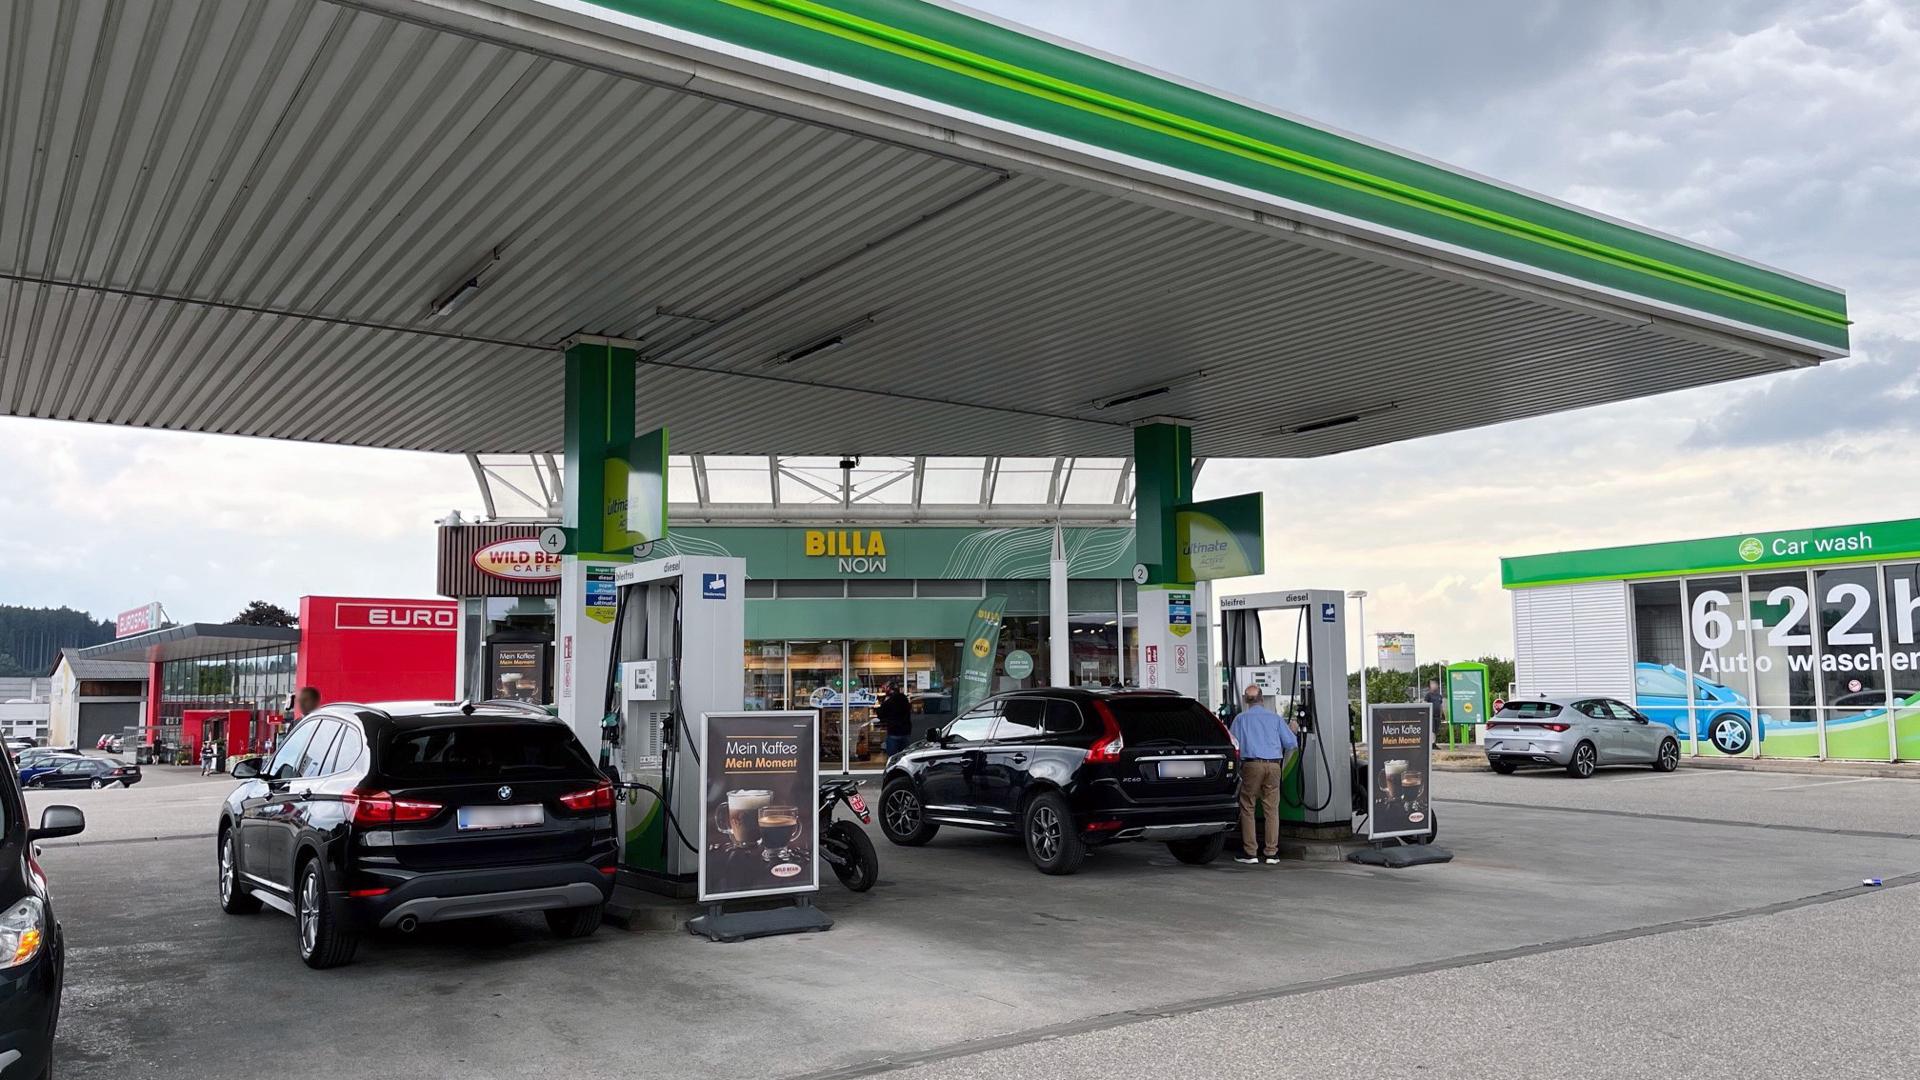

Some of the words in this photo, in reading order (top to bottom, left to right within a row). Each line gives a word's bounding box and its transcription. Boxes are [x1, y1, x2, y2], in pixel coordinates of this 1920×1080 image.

[547, 533, 557, 547] 4
[805, 531, 886, 556] BILLA
[1772, 538, 1809, 556] Car
[1814, 531, 1872, 551] wash
[489, 551, 530, 564] WILD
[513, 564, 552, 572] CAFE
[664, 561, 681, 573] diesel
[838, 557, 887, 573] NOW
[1137, 569, 1144, 579] 2
[1220, 598, 1246, 607] bleifrei
[1286, 593, 1309, 602] diesel
[368, 609, 453, 626] EURO
[975, 644, 988, 653] NEU
[1699, 650, 1773, 673] Auto
[1382, 725, 1400, 735] Mein
[1401, 724, 1421, 735] Kaffee
[1382, 737, 1398, 745] Mein
[725, 742, 758, 755] Mein
[761, 741, 798, 755] Kaffee
[725, 758, 753, 769] Mein
[755, 757, 797, 768] Moment
